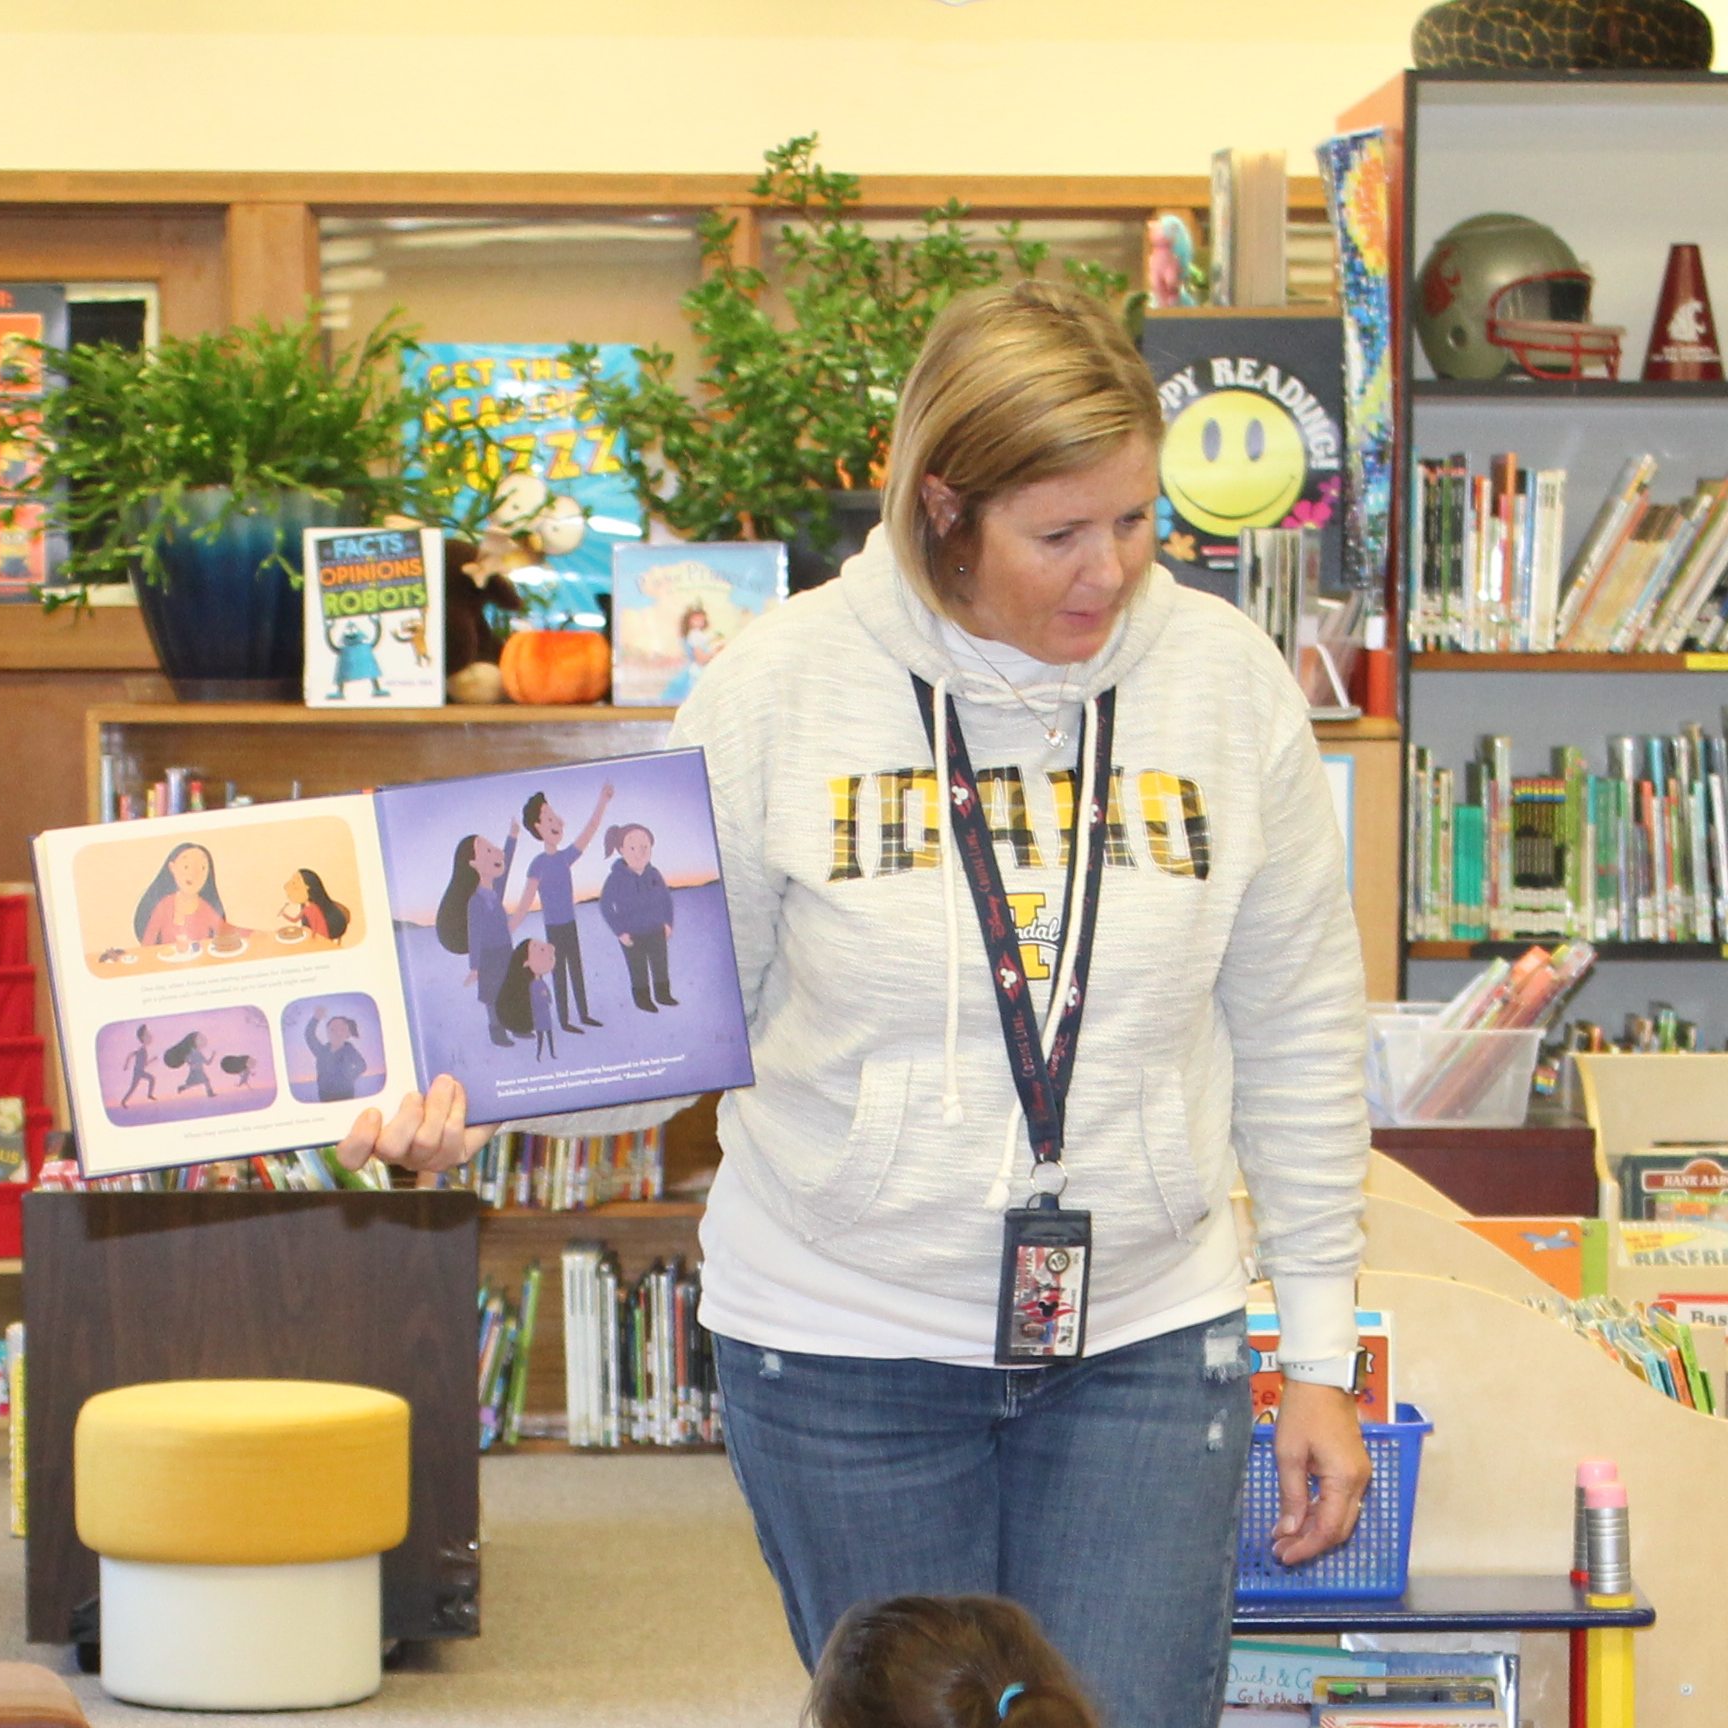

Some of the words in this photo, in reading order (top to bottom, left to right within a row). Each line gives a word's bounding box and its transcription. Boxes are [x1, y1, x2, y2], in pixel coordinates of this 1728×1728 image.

[428, 358, 496, 391] GET
[506, 358, 573, 381] THE
[1209, 356, 1340, 471] READING!
[333, 532, 405, 559] FACTS
[319, 557, 423, 586] OPINIONS
[324, 583, 427, 617] ROBOTS
[1664, 1175, 1698, 1186] HANK
[1225, 1663, 1273, 1686] Duck
[1237, 1688, 1256, 1702] Go
[1258, 1689, 1272, 1703] to
[1273, 1690, 1294, 1704] the
